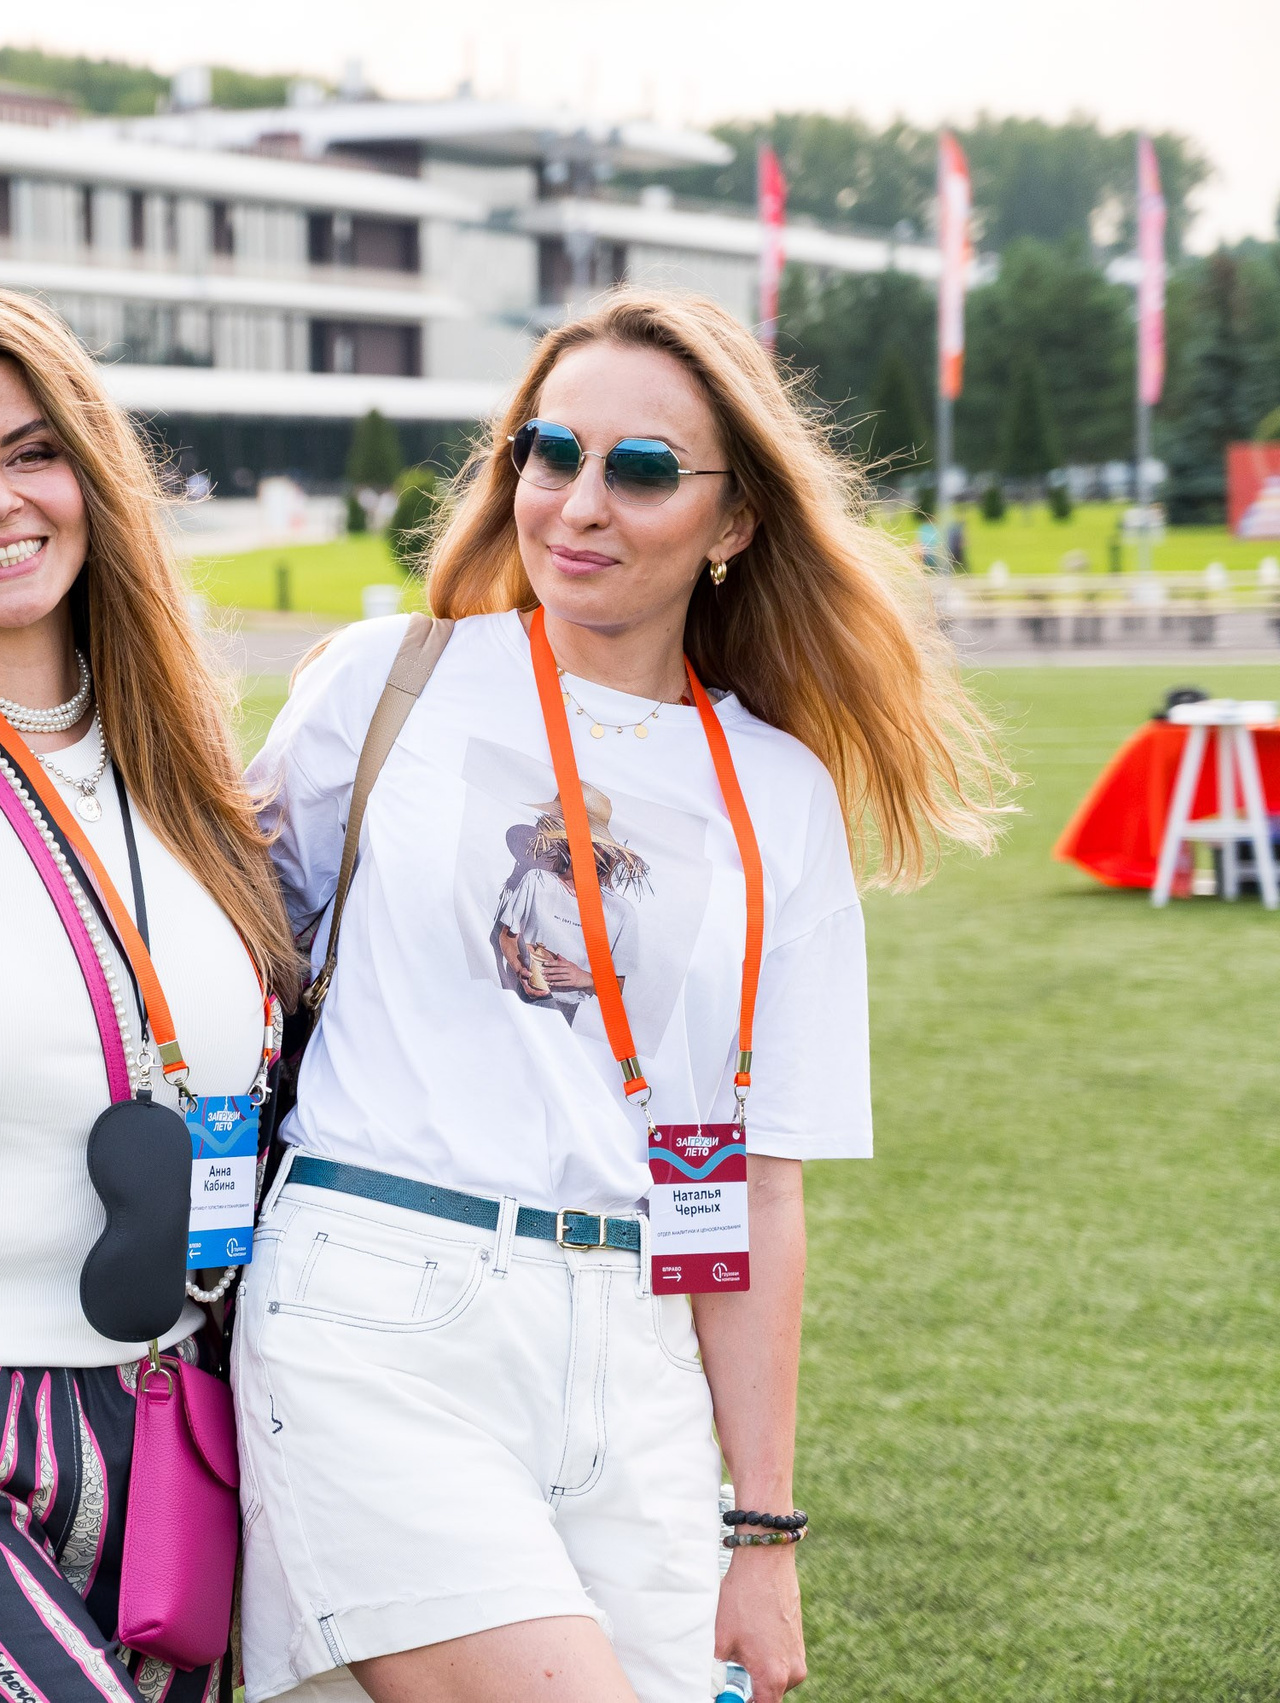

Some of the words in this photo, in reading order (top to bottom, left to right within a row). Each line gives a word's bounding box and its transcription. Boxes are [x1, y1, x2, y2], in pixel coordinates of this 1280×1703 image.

[207, 1111, 240, 1122] ЗАГРУЗИ
[213, 1122, 232, 1131] ЛЕТО
[676, 1136, 719, 1147] ЗАГРУЗИ
[684, 1147, 709, 1157] ЛЕТО
[209, 1165, 231, 1177] Анна
[203, 1179, 235, 1192] Кабина
[673, 1188, 721, 1202] Наталья
[675, 1202, 721, 1218] Черных
